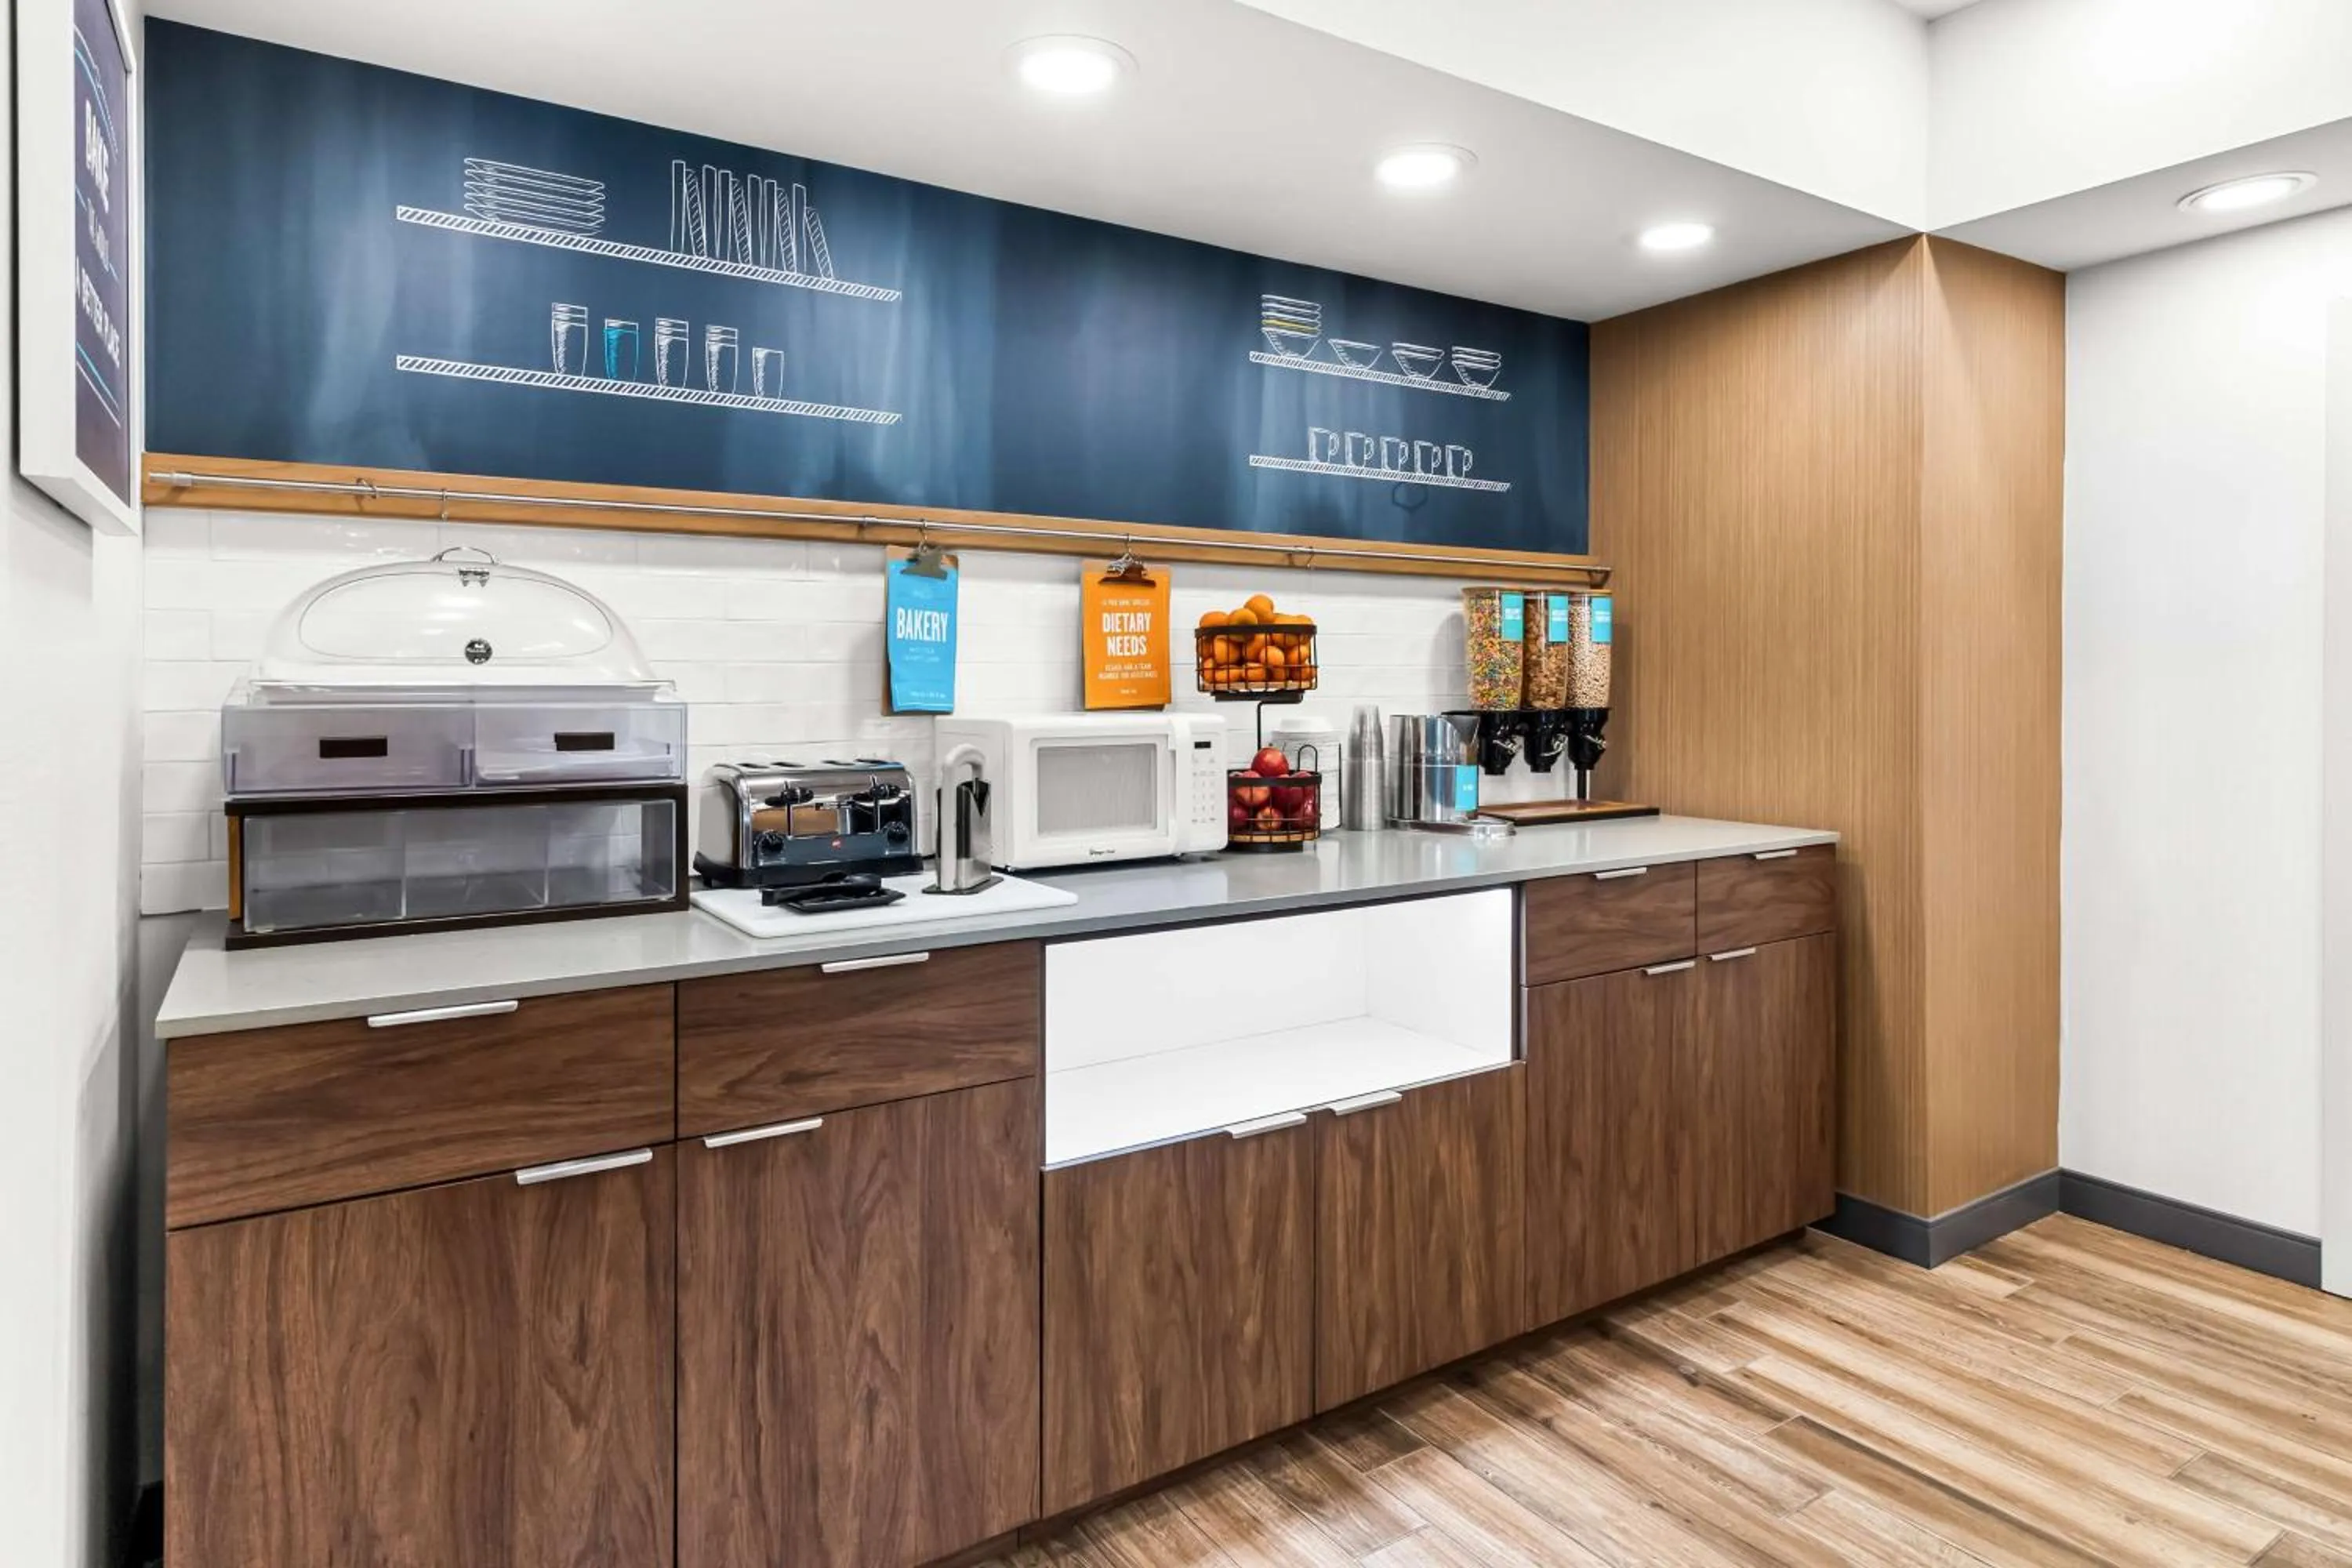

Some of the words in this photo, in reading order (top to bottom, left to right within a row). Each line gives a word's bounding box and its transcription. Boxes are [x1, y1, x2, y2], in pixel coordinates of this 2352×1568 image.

[896, 608, 948, 642] BAKERY
[1102, 612, 1152, 633] DIETARY
[1106, 635, 1147, 656] NEEDS
